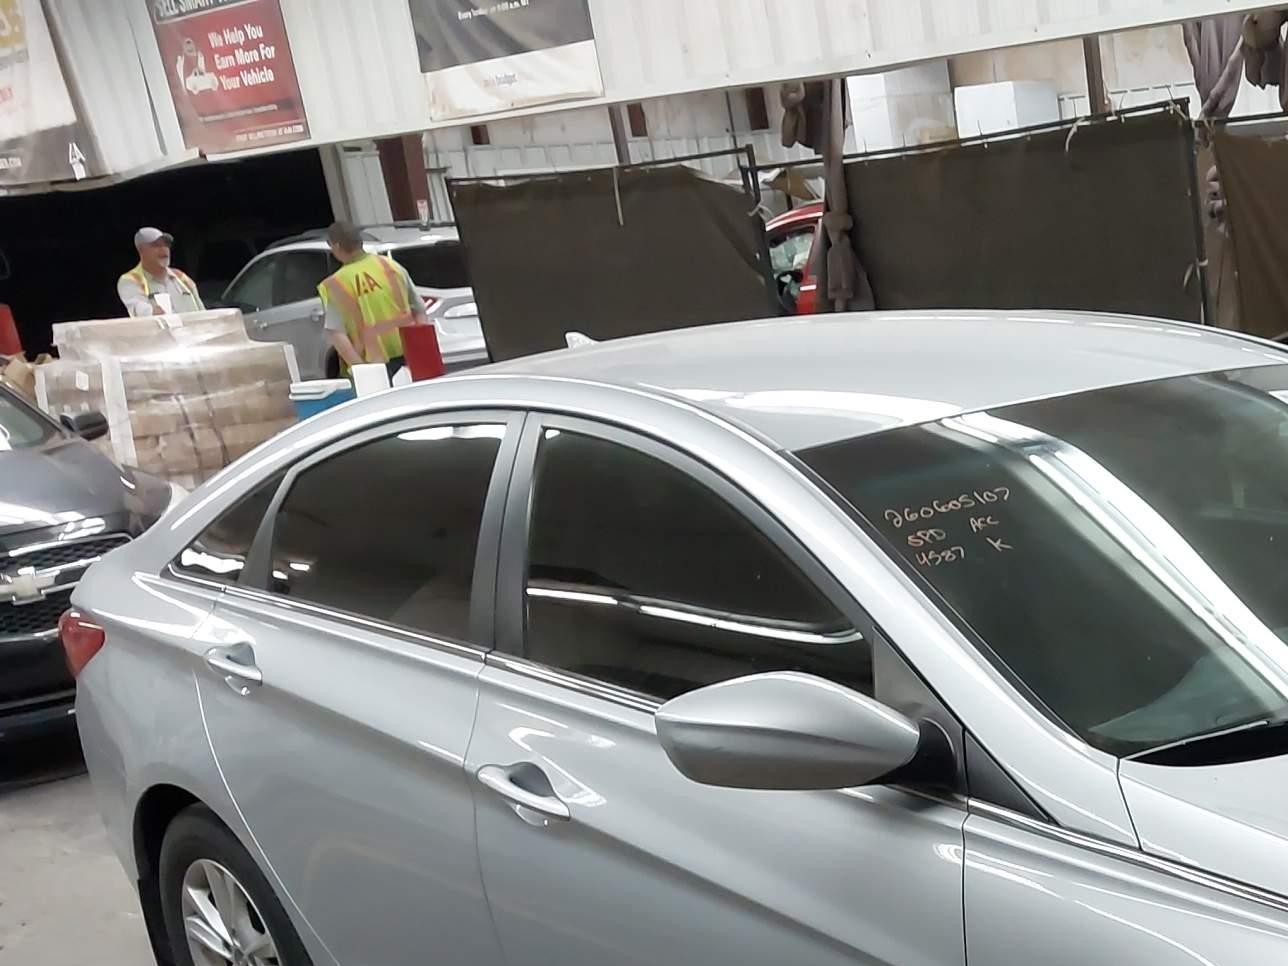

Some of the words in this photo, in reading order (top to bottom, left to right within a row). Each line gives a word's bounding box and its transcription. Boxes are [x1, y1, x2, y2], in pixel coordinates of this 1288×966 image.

[207, 31, 223, 48] We
[222, 26, 245, 46] Help
[244, 23, 263, 40] You
[214, 53, 236, 70] Earn
[234, 47, 260, 66] More
[259, 43, 275, 60] For
[219, 74, 241, 91] Your
[240, 66, 274, 87] Vehicle
[985, 536, 1014, 552] K
